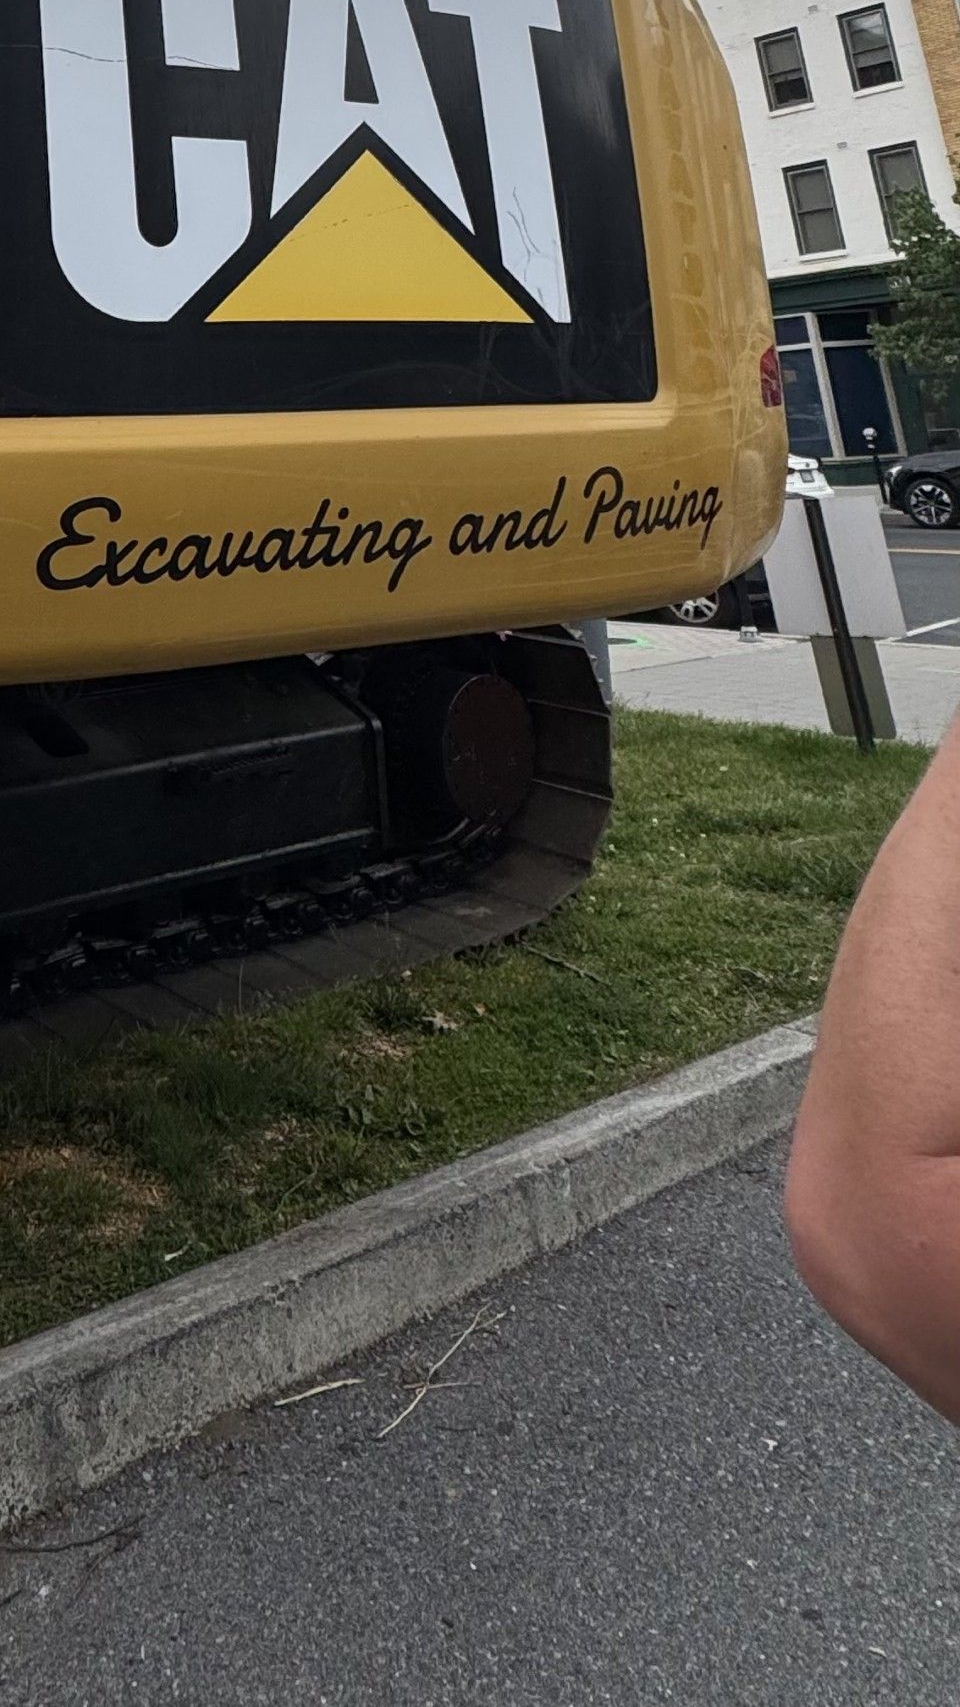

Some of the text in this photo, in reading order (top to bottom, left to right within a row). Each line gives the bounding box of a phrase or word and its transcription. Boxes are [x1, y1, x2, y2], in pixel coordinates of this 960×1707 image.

[36, 496, 432, 592] Excavating
[450, 476, 566, 554] and
[583, 466, 724, 551] Paving
